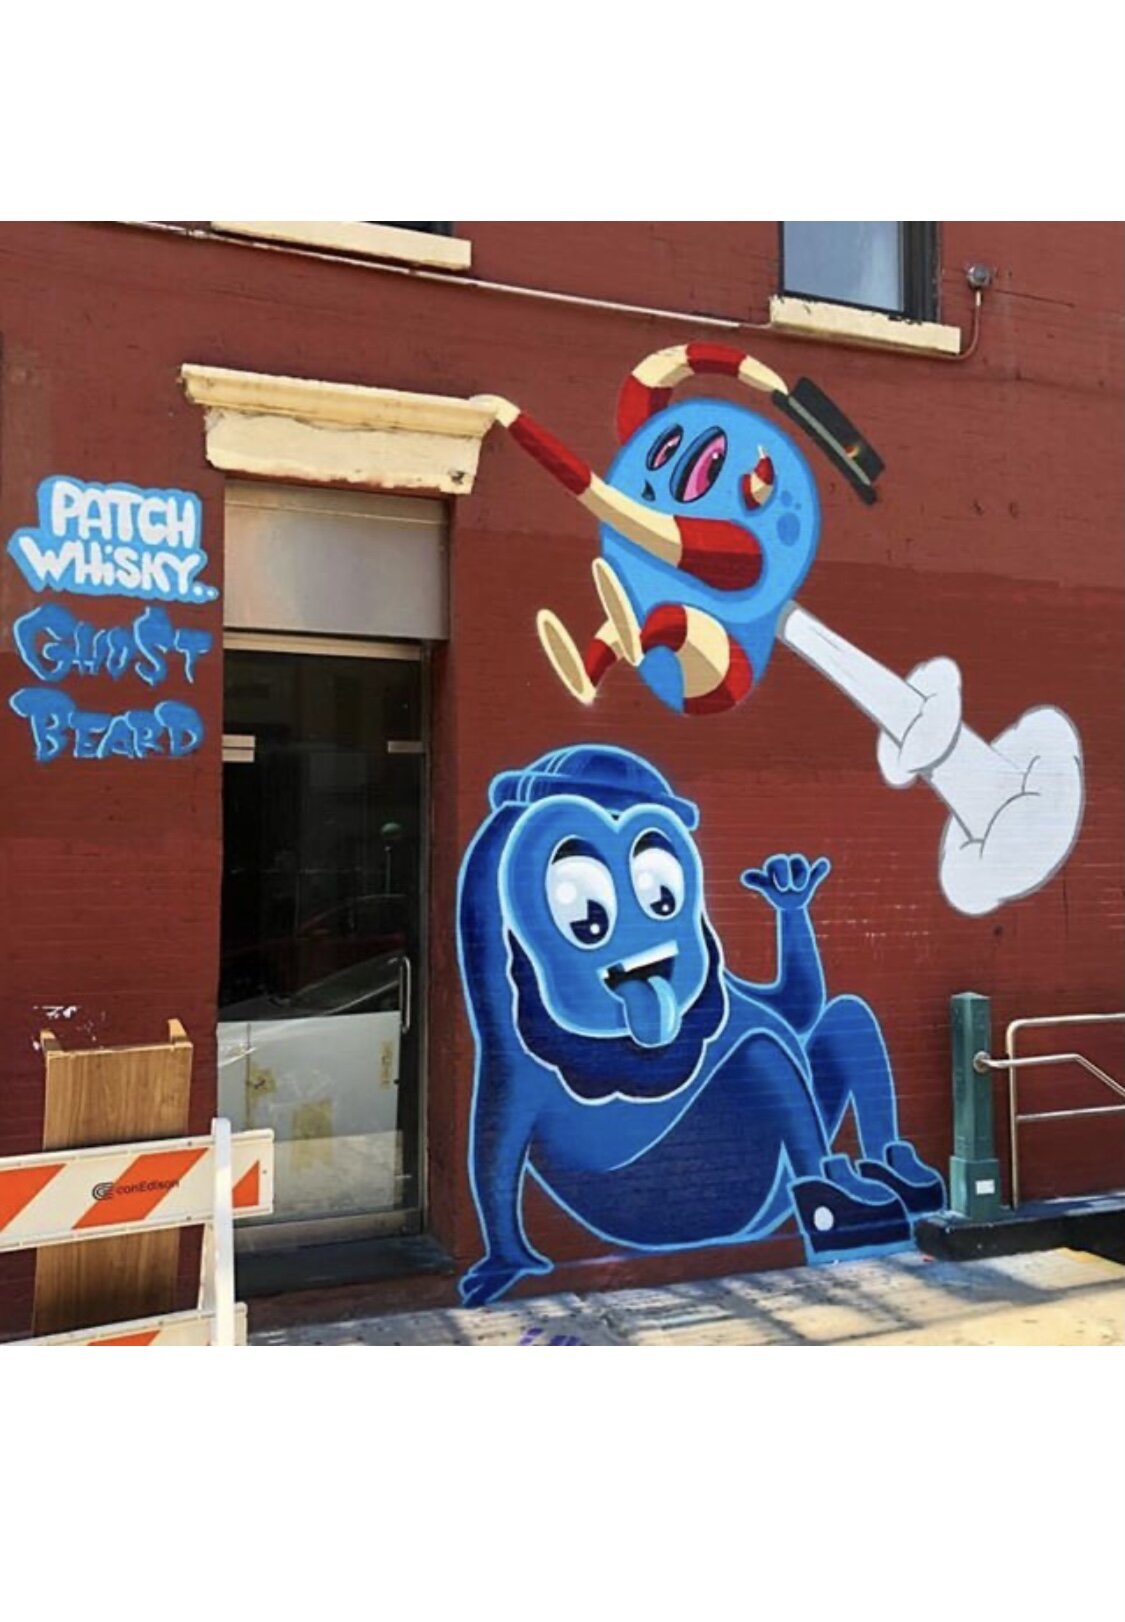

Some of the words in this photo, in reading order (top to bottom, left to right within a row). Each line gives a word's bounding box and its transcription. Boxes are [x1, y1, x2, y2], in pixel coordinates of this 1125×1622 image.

[52, 480, 198, 549] PATCH
[13, 604, 213, 686] GHOST
[9, 688, 205, 762] BEARD
[115, 1180, 180, 1195] conEdison
